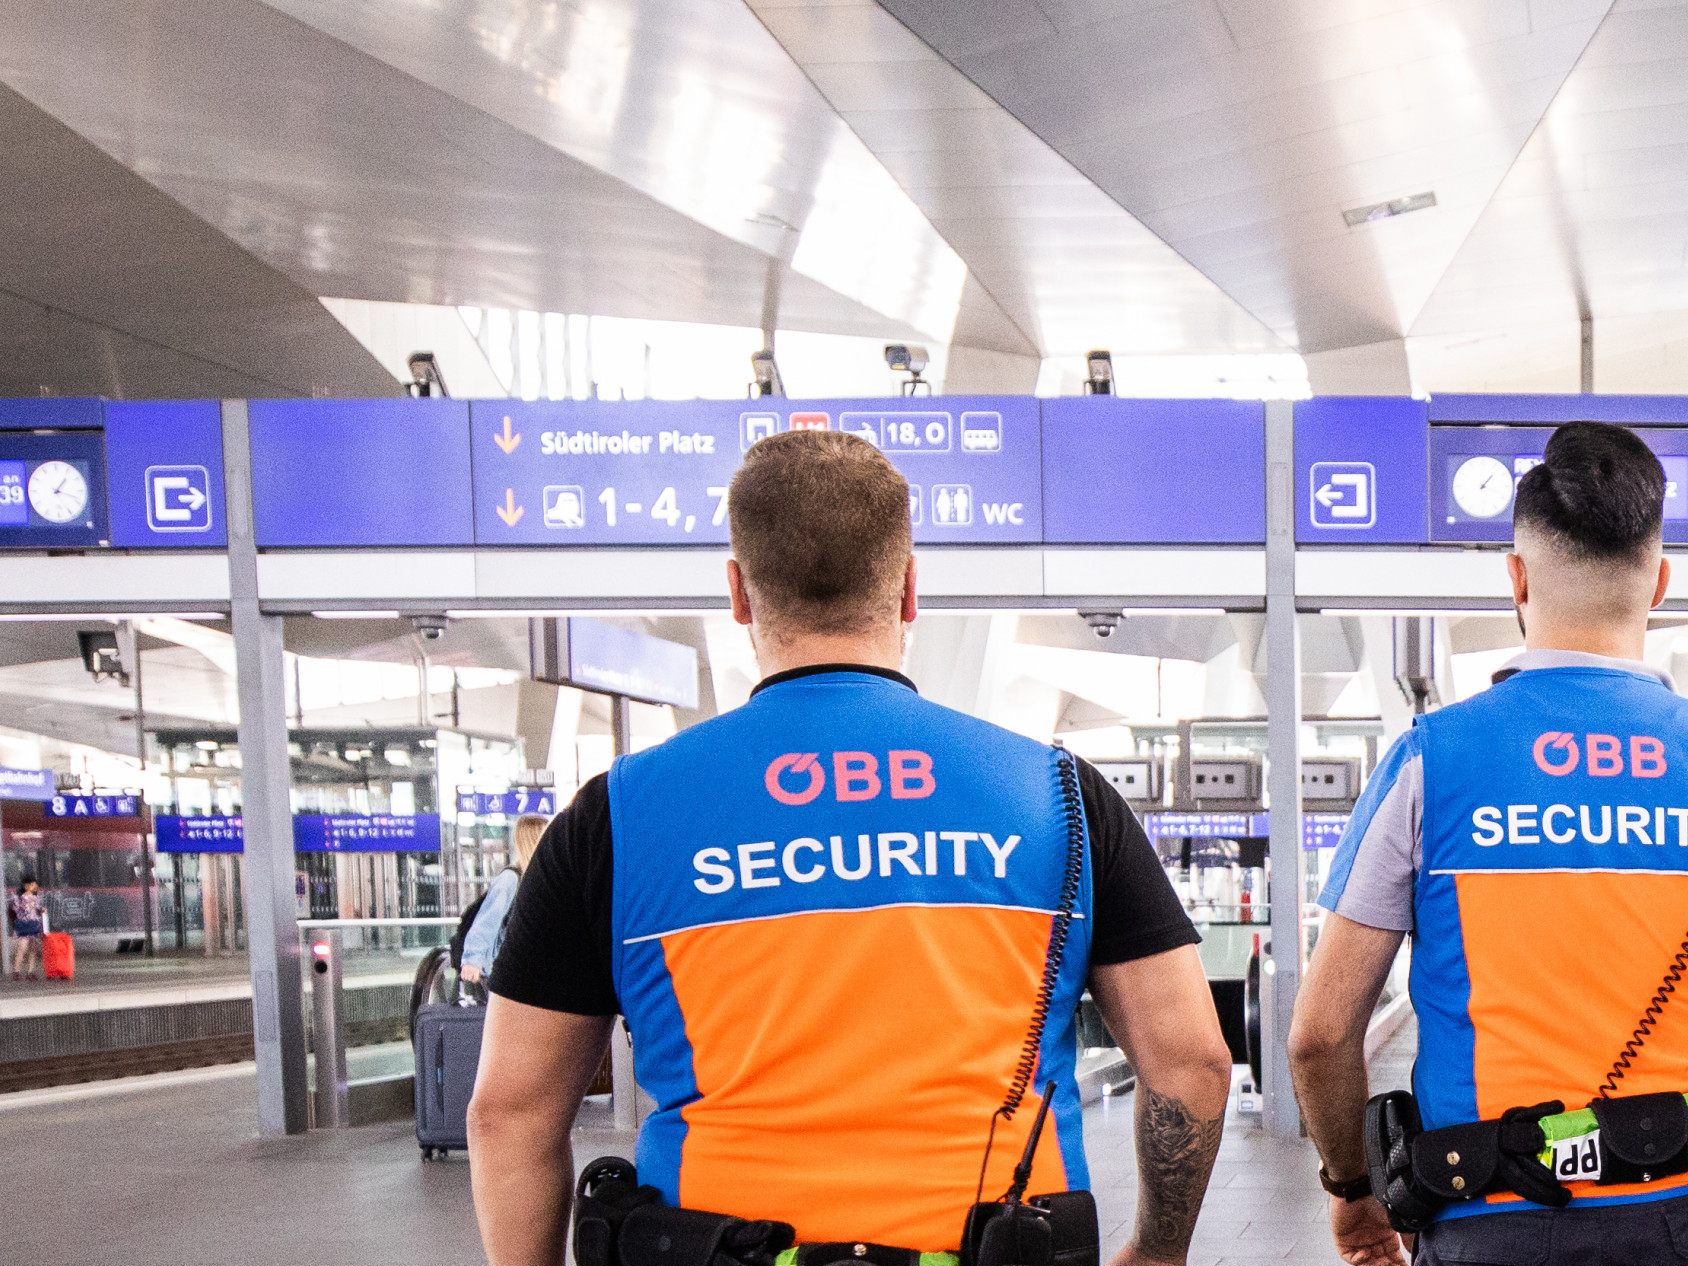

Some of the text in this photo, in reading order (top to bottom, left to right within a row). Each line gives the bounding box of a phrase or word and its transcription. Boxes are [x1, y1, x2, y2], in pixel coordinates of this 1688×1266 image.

[540, 429, 716, 455] Südtiroler Platz
[886, 422, 921, 447] 18,
[981, 503, 1025, 525] WC
[1533, 731, 1668, 778] ÖBB
[764, 749, 937, 806] ÖBB
[692, 831, 1023, 895] SECURITY
